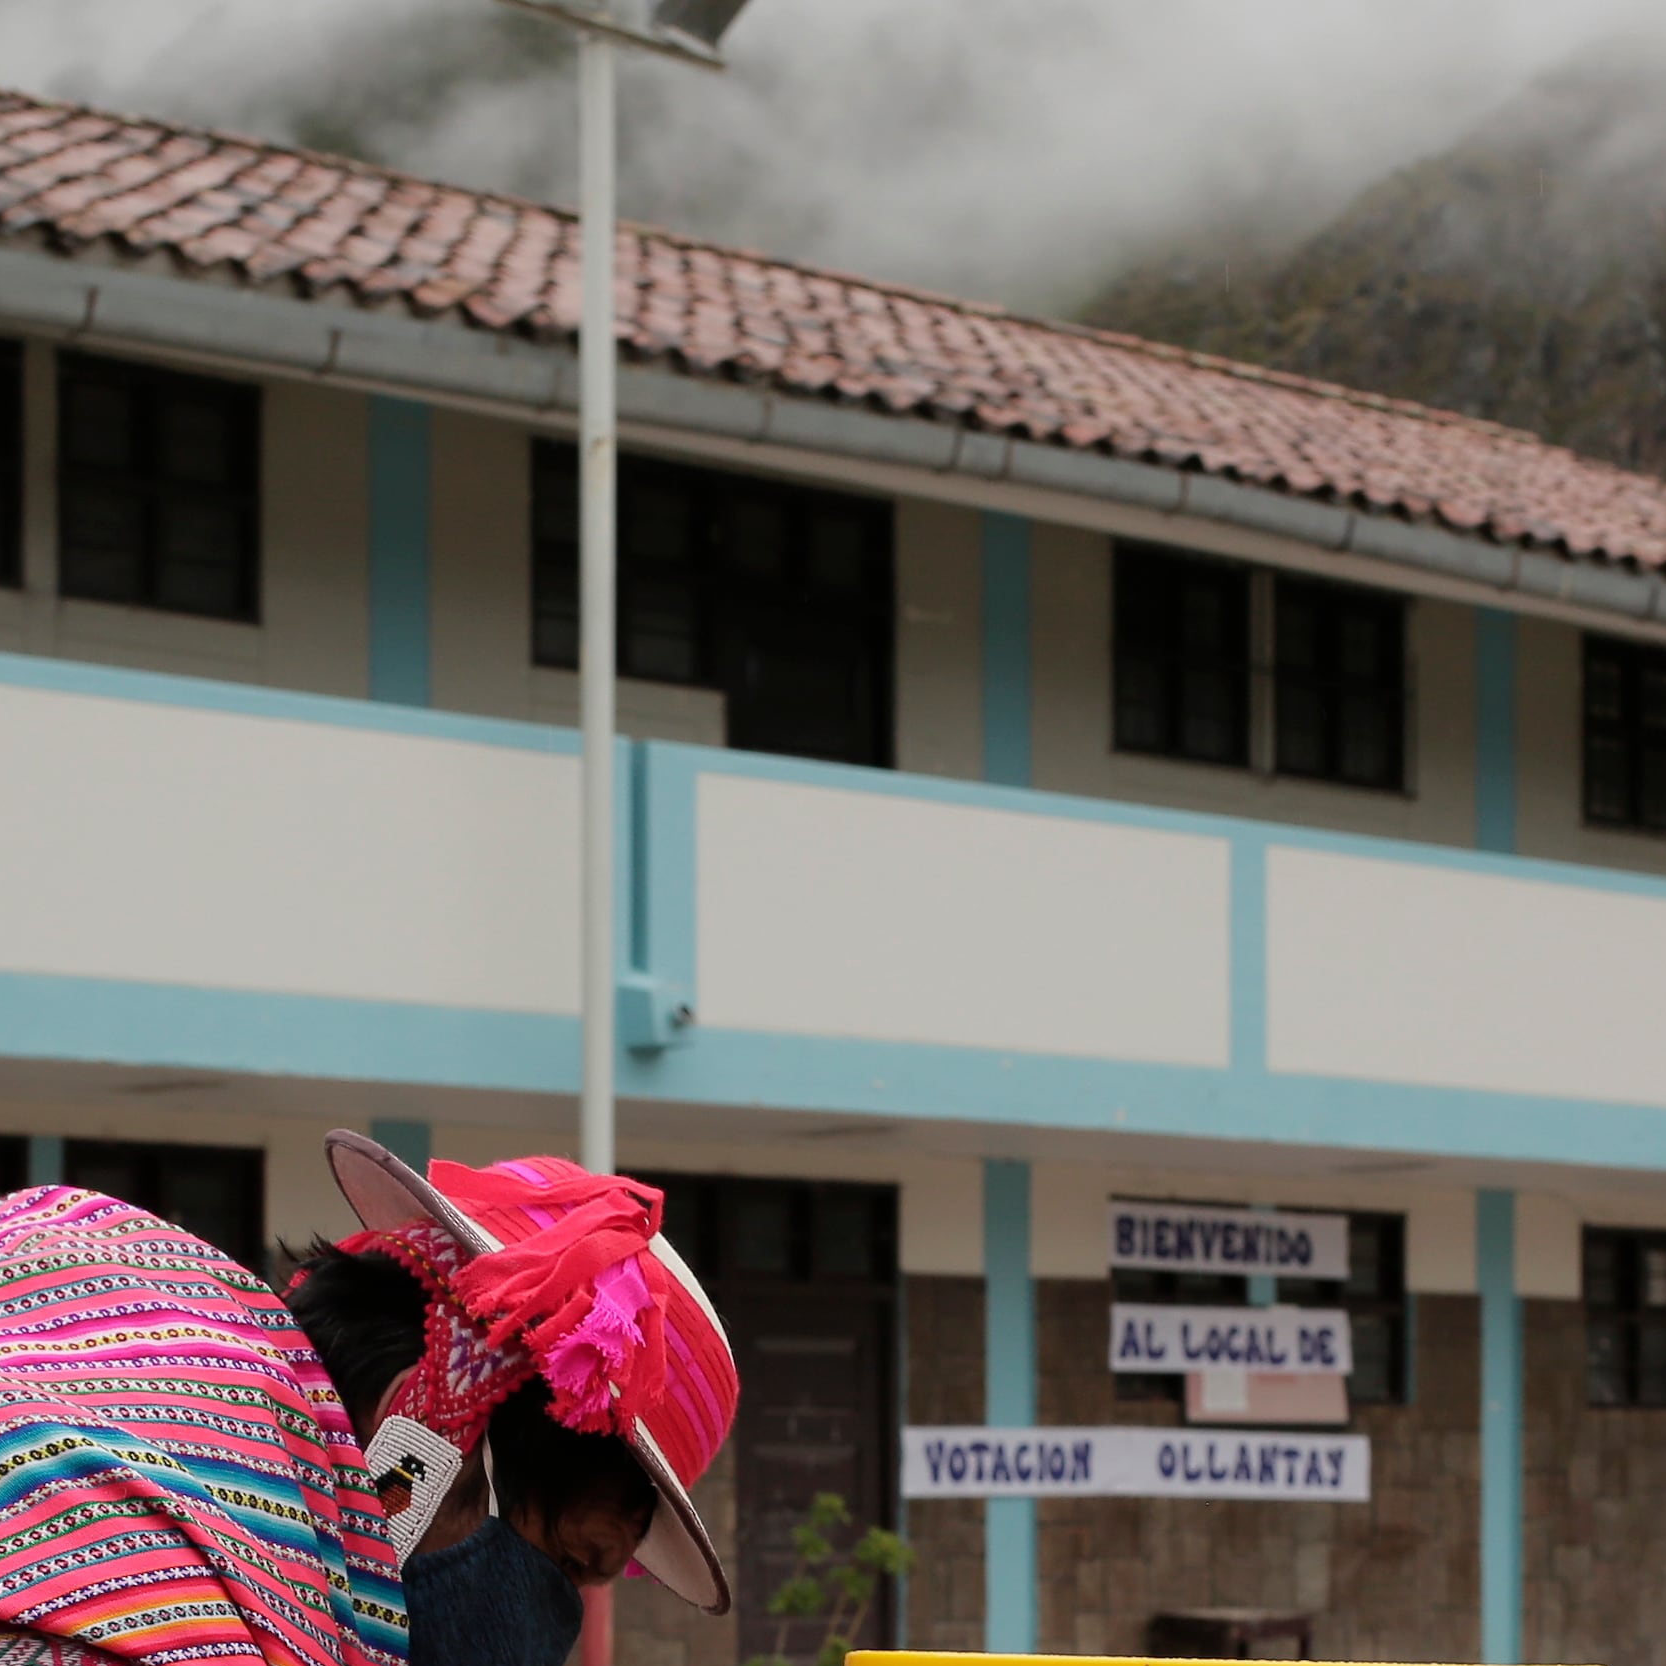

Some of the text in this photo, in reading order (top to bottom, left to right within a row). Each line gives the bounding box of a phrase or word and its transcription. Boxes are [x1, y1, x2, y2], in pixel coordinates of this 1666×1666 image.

[1114, 1216, 1314, 1267] BIENVENIDO
[1119, 1320, 1338, 1365] AL LOCAL DE
[924, 1439, 1346, 1488] VOTACION OLLANTAY
